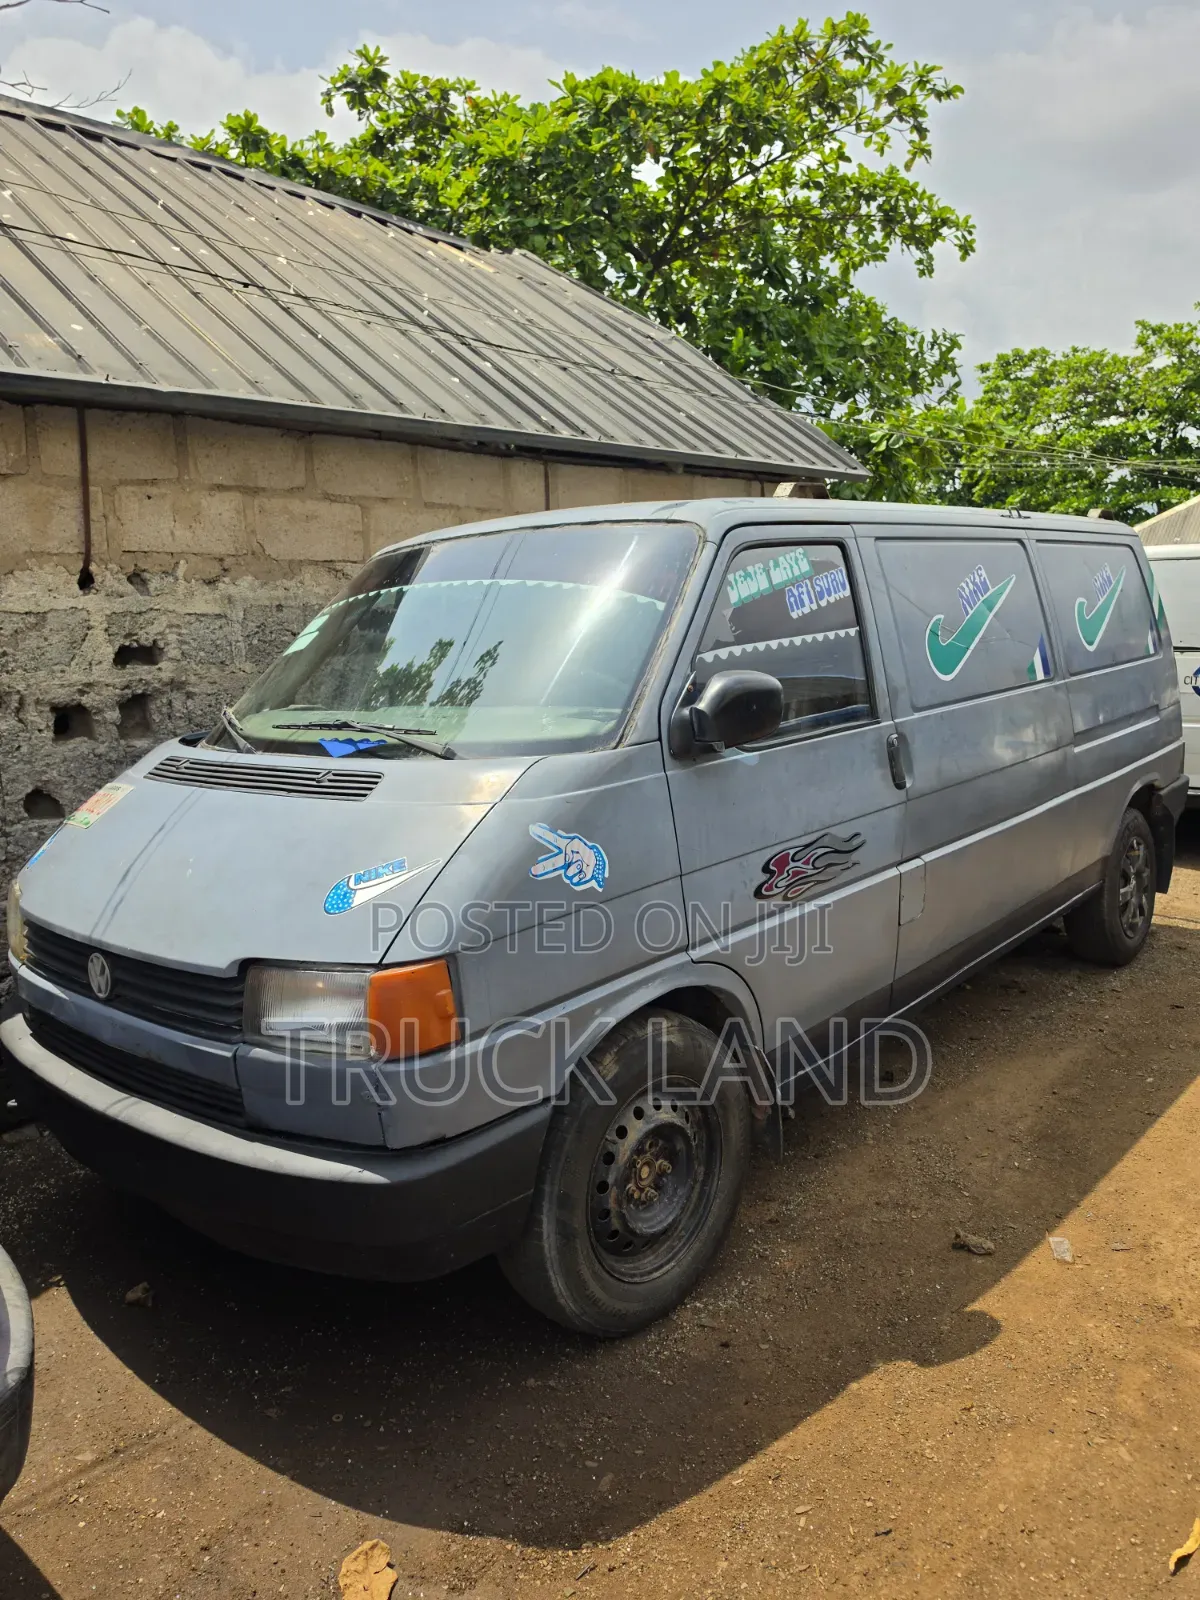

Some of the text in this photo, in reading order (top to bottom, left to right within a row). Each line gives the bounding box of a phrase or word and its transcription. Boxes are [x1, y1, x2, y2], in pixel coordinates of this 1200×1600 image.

[727, 547, 814, 608] JEJE LAYE
[785, 567, 850, 619] AFI SURU
[354, 858, 407, 886] NIKE
